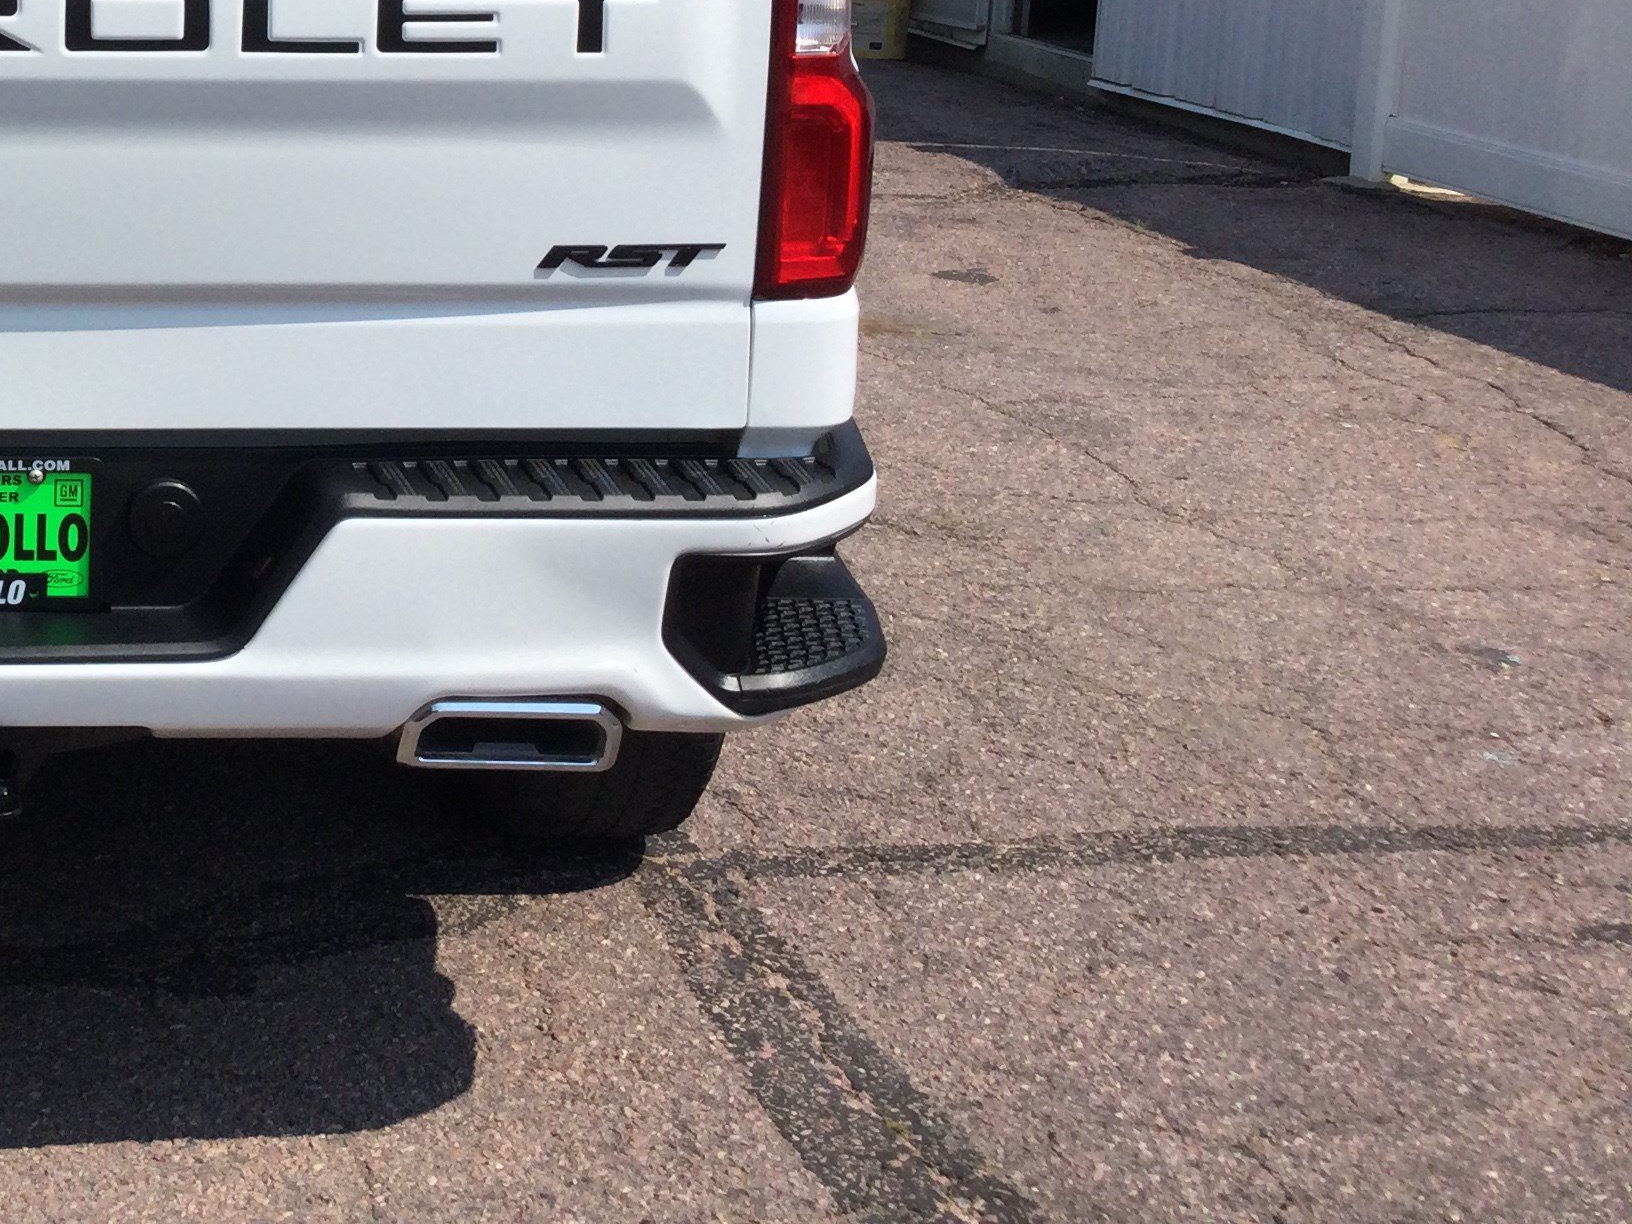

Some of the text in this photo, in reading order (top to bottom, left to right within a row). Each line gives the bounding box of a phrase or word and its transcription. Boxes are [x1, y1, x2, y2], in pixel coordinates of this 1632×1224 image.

[536, 243, 727, 268] RST
[59, 485, 79, 499] GM
[47, 572, 76, 586] Ford
